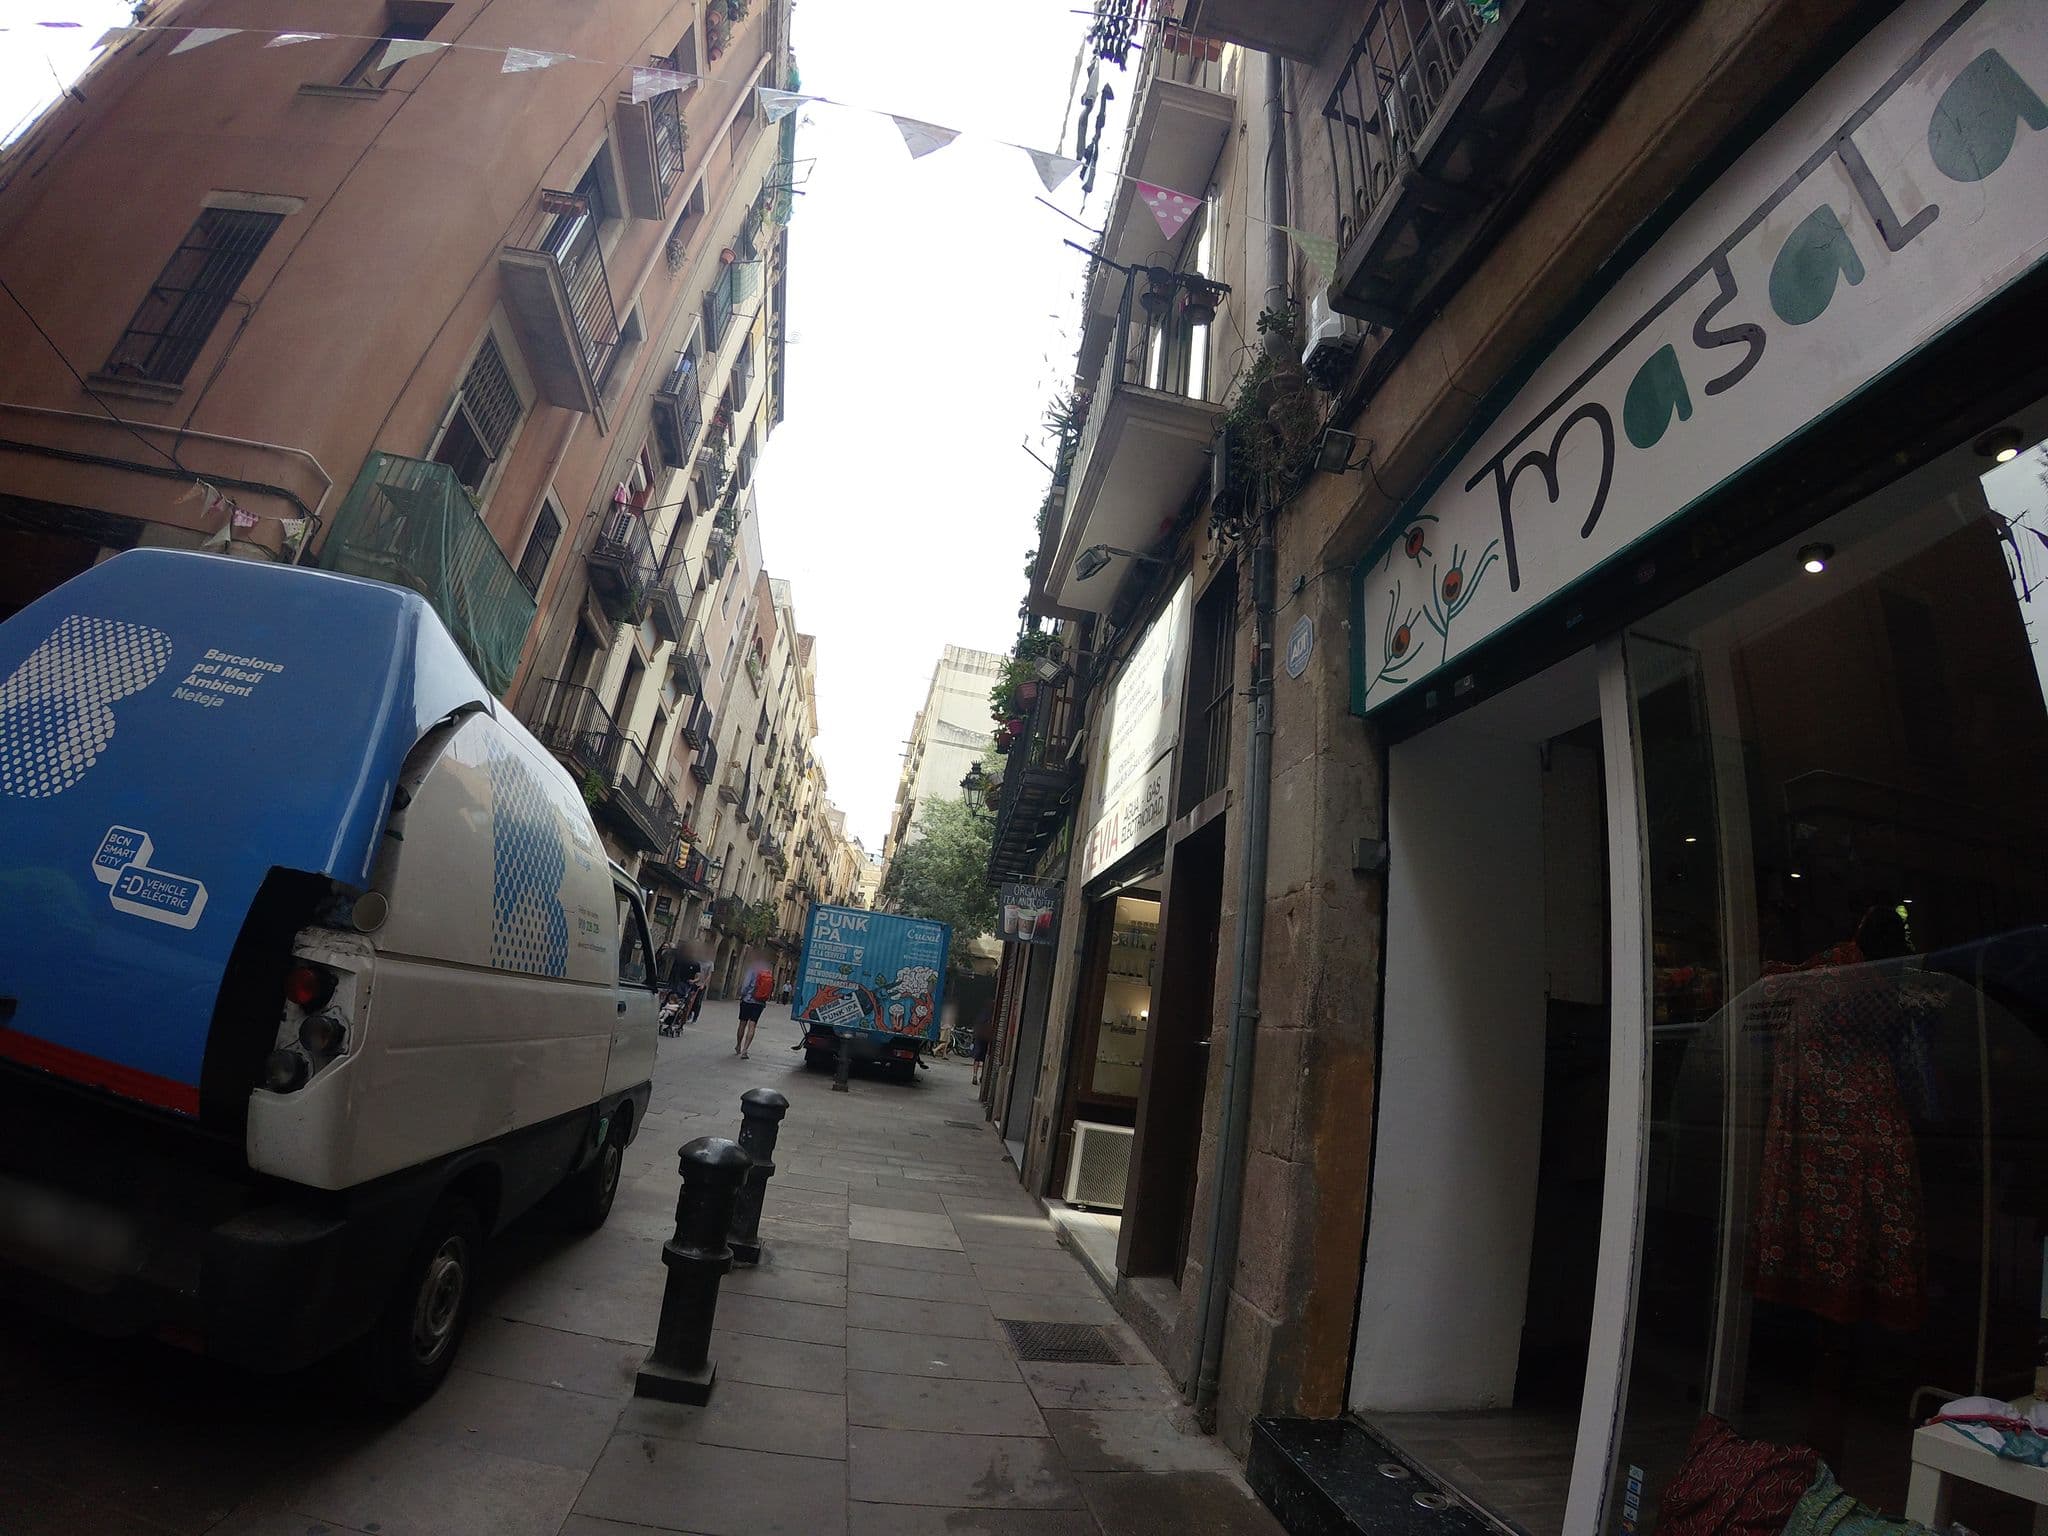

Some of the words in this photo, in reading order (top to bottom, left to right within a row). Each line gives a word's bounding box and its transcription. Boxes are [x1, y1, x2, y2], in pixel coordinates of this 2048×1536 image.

[204, 648, 285, 674] Barcelona
[191, 663, 222, 675] pel
[220, 666, 265, 684] Medi
[182, 673, 254, 697] Ambient
[171, 686, 225, 707] Neteja
[1146, 775, 1161, 803] GAS
[109, 833, 133, 847] BCN
[98, 854, 122, 867] CITY
[103, 844, 136, 859] SMART
[146, 878, 188, 897] VEHICLE
[1013, 885, 1049, 899] ORGANIC
[141, 889, 189, 909] ELECTRIC
[1003, 895, 1016, 905] TEA
[815, 911, 869, 932] PUNK
[813, 925, 841, 942] IPA
[810, 941, 818, 949] LA
[822, 1009, 845, 1022] PUNK
[845, 1003, 859, 1013] IPA
